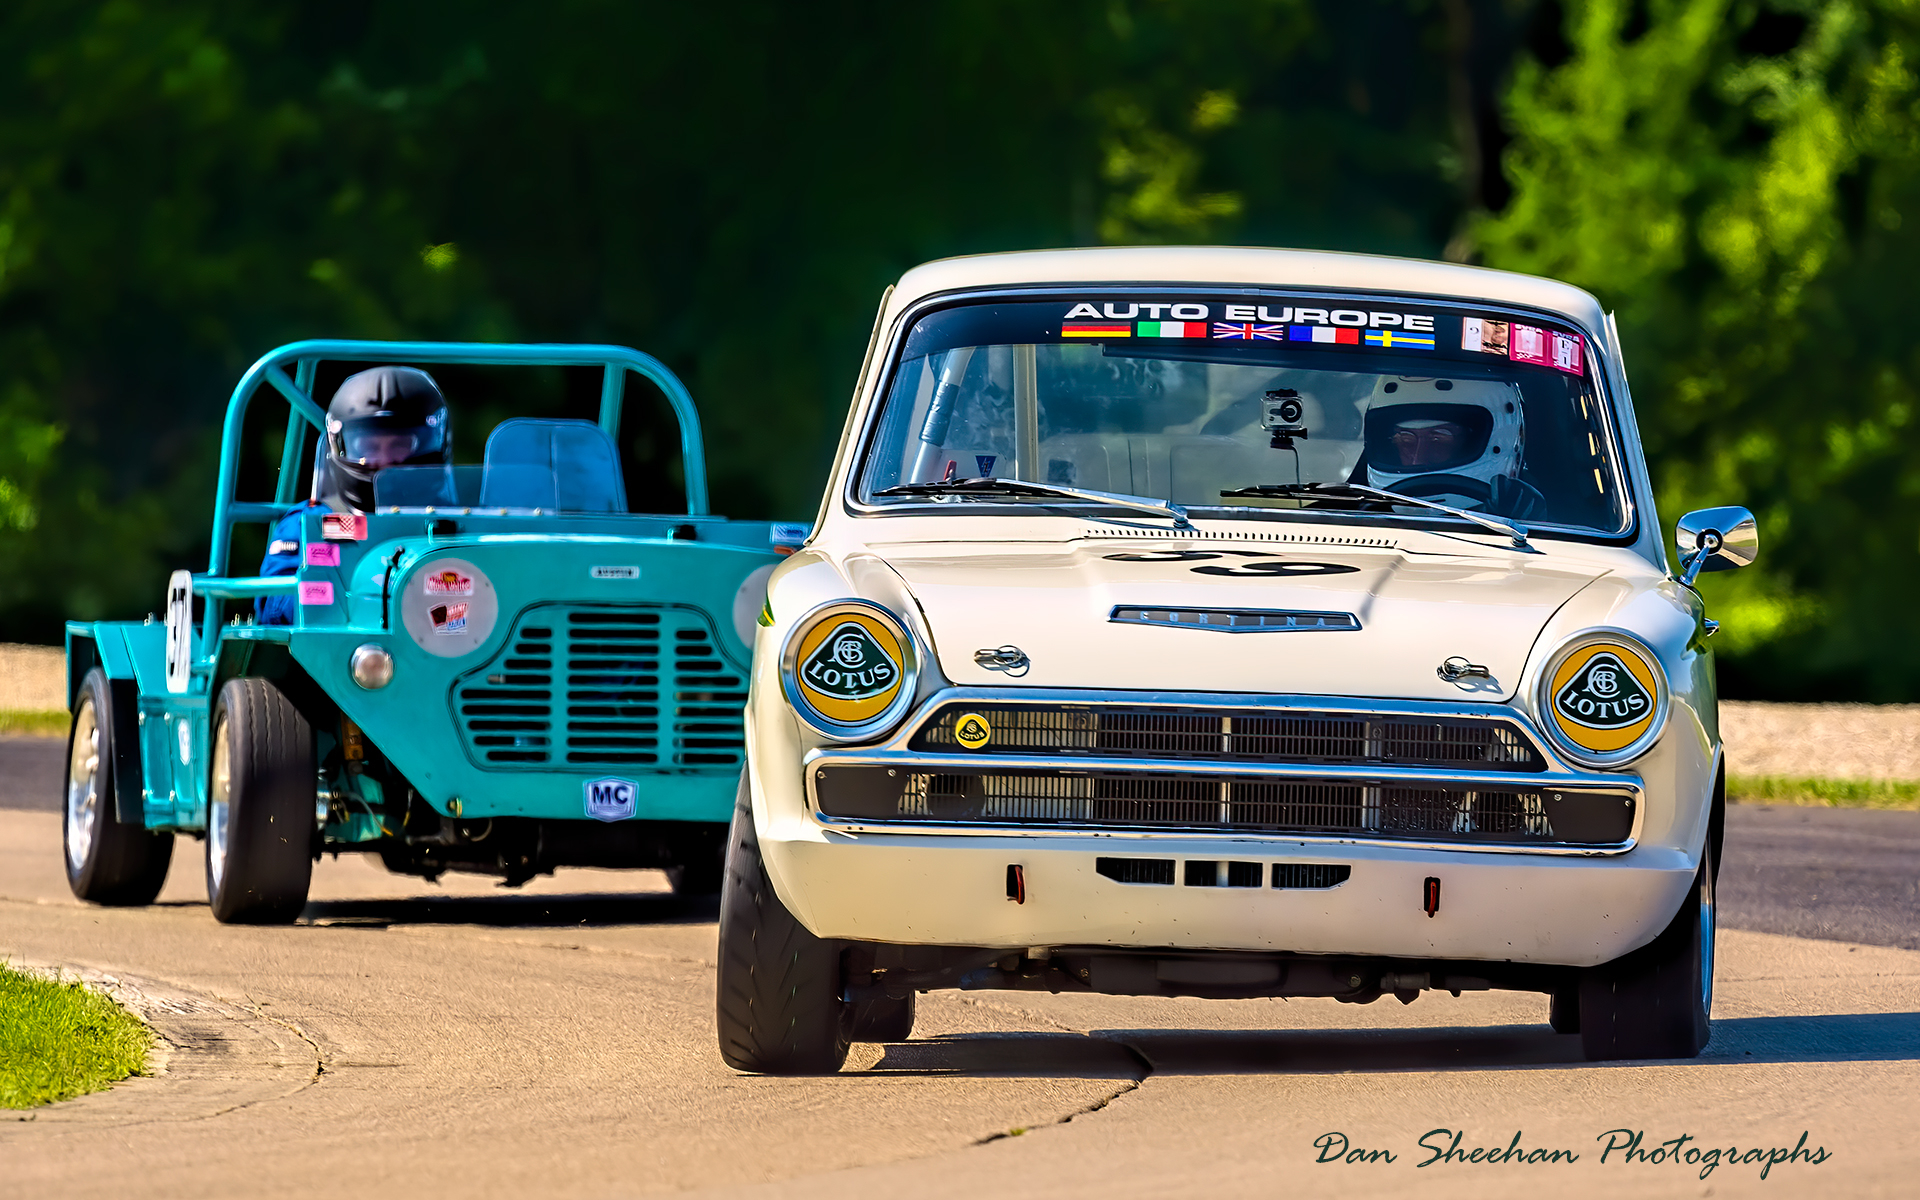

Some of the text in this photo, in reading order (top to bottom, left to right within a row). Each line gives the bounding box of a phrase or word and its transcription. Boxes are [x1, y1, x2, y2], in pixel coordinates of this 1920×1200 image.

[1064, 303, 1435, 331] AUTO EUROPE
[1140, 610, 1326, 627] CORTINA
[808, 660, 891, 689] LOTUS
[1563, 690, 1645, 719] LOTUS
[960, 730, 985, 740] LOTUS
[593, 786, 628, 804] MC
